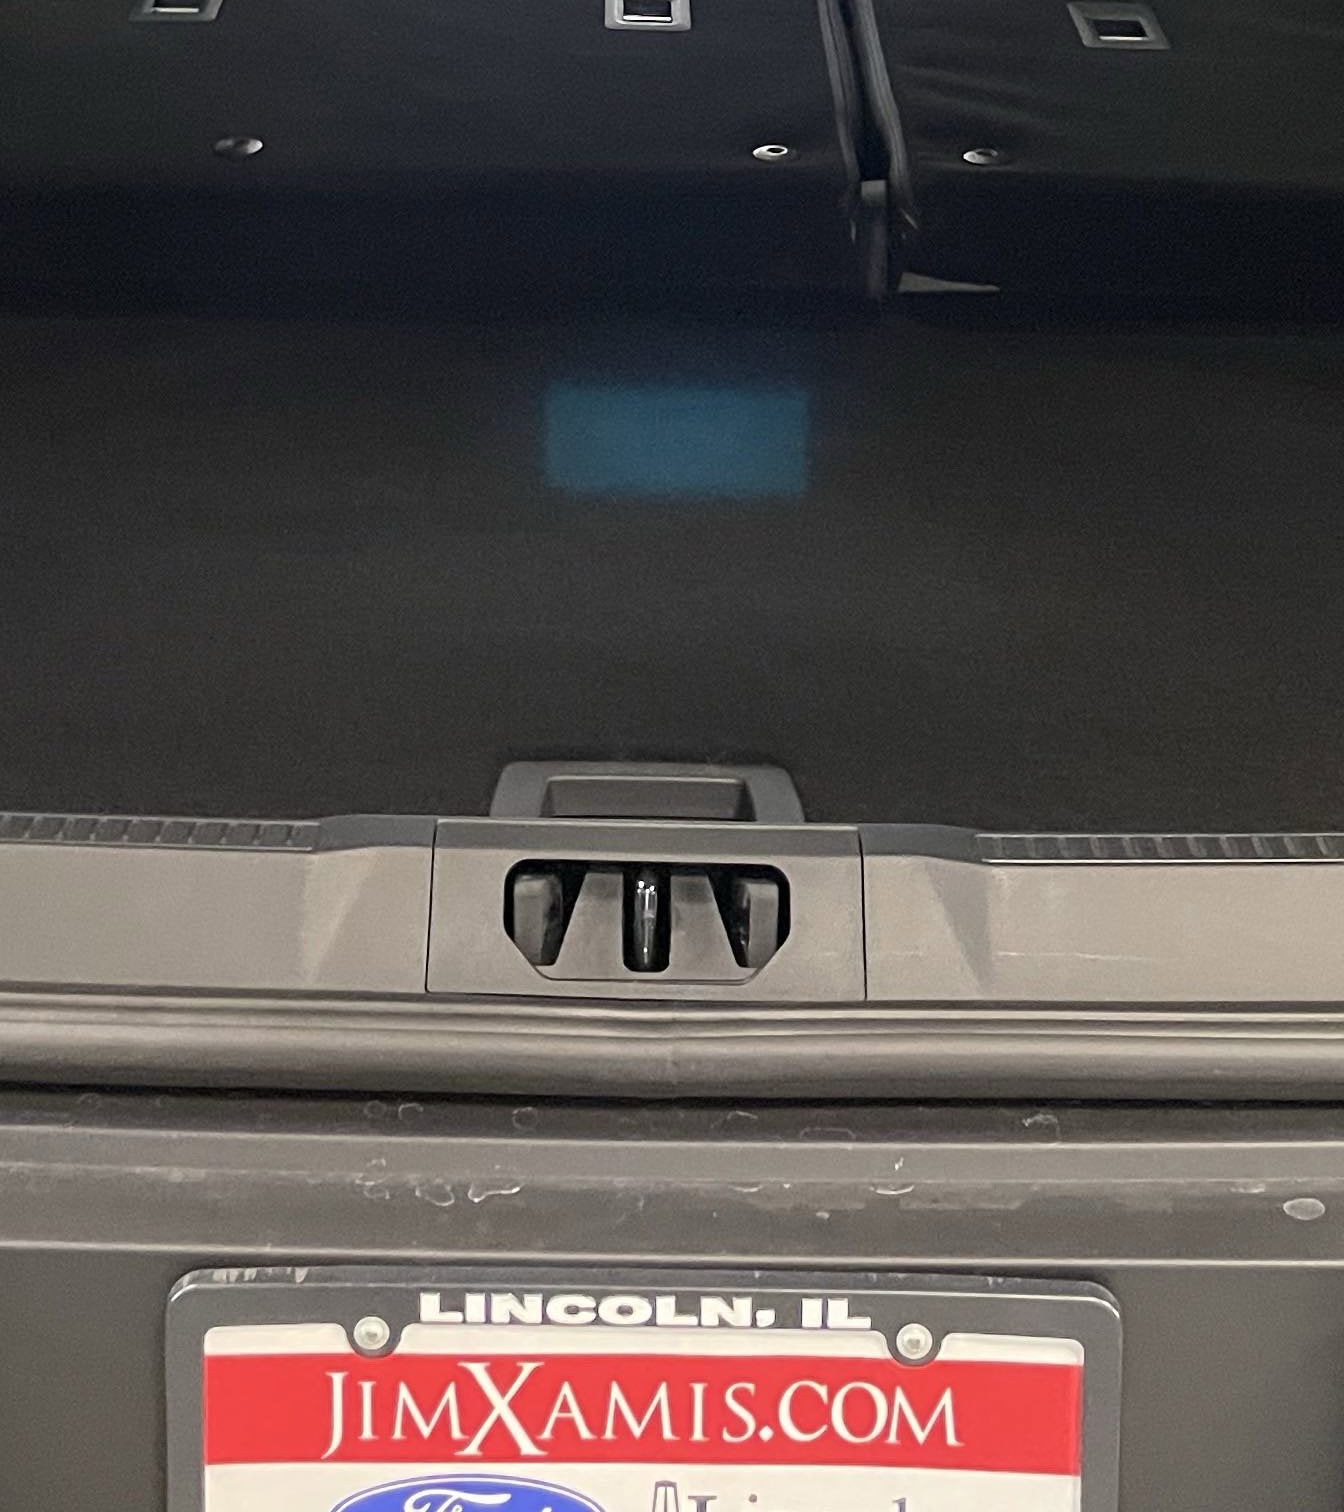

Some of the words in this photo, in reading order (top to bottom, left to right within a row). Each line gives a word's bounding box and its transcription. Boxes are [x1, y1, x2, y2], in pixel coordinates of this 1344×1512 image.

[419, 1291, 776, 1328] LINCOLN,
[800, 1297, 872, 1329] IL
[321, 1361, 965, 1459] JIMXAMIS.COM
